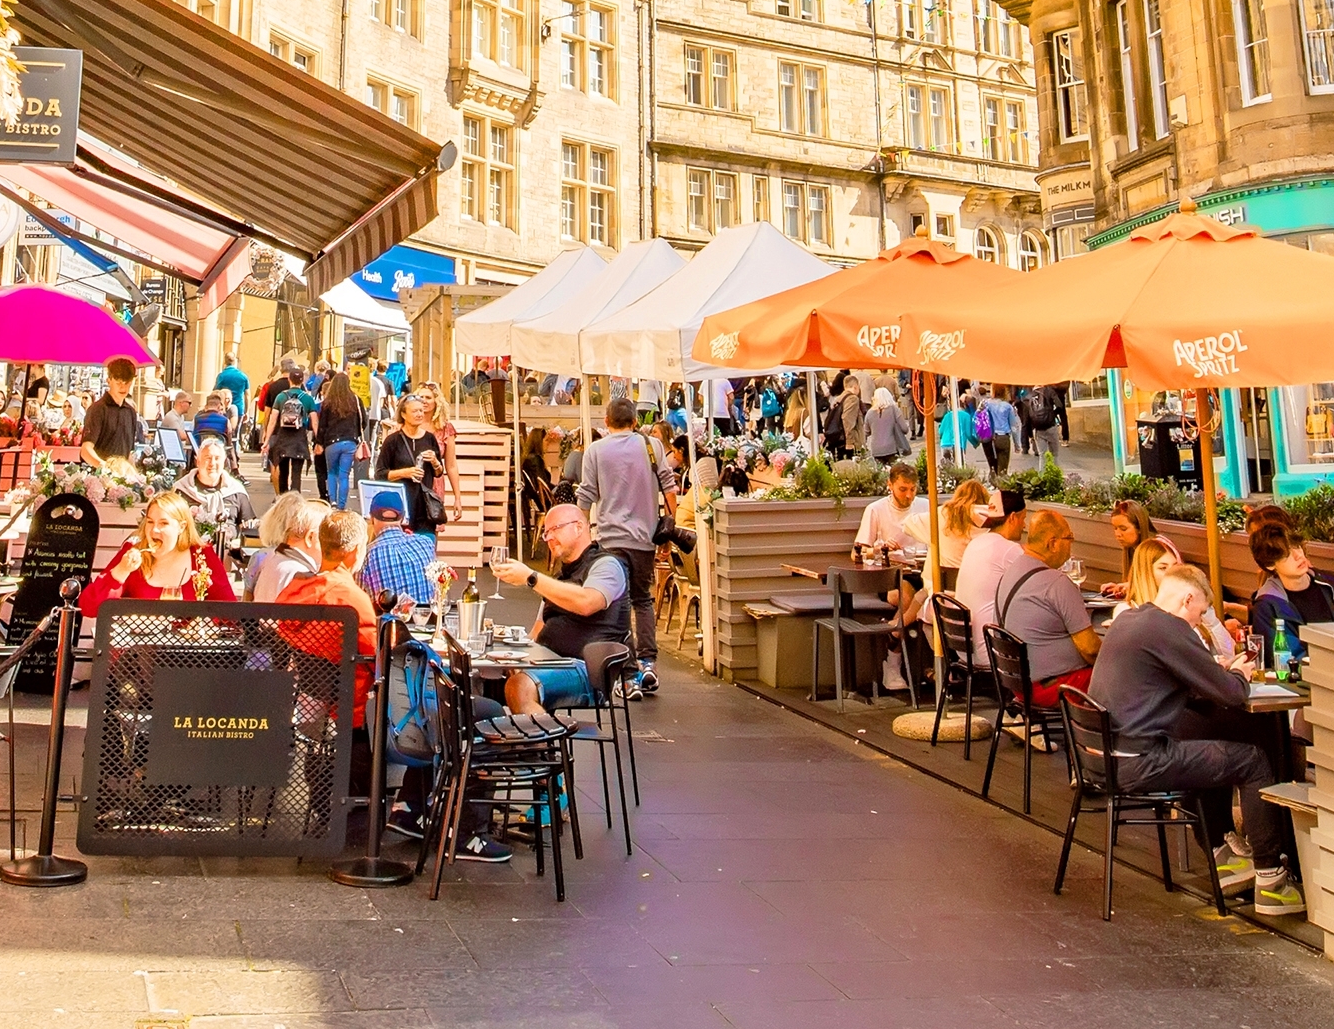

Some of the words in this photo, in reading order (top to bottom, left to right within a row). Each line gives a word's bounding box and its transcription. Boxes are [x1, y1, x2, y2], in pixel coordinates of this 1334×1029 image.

[5, 123, 62, 136] BISTRO
[1047, 185, 1060, 196] THE
[362, 269, 383, 284] Health
[916, 328, 967, 353] APEROL
[1172, 329, 1248, 367] APEROL
[1189, 354, 1240, 378] SPRITZ
[173, 716, 199, 731] LA
[203, 716, 269, 731] LOCANDA
[187, 731, 225, 740] ITALIAN
[226, 731, 255, 740] BISTRO
